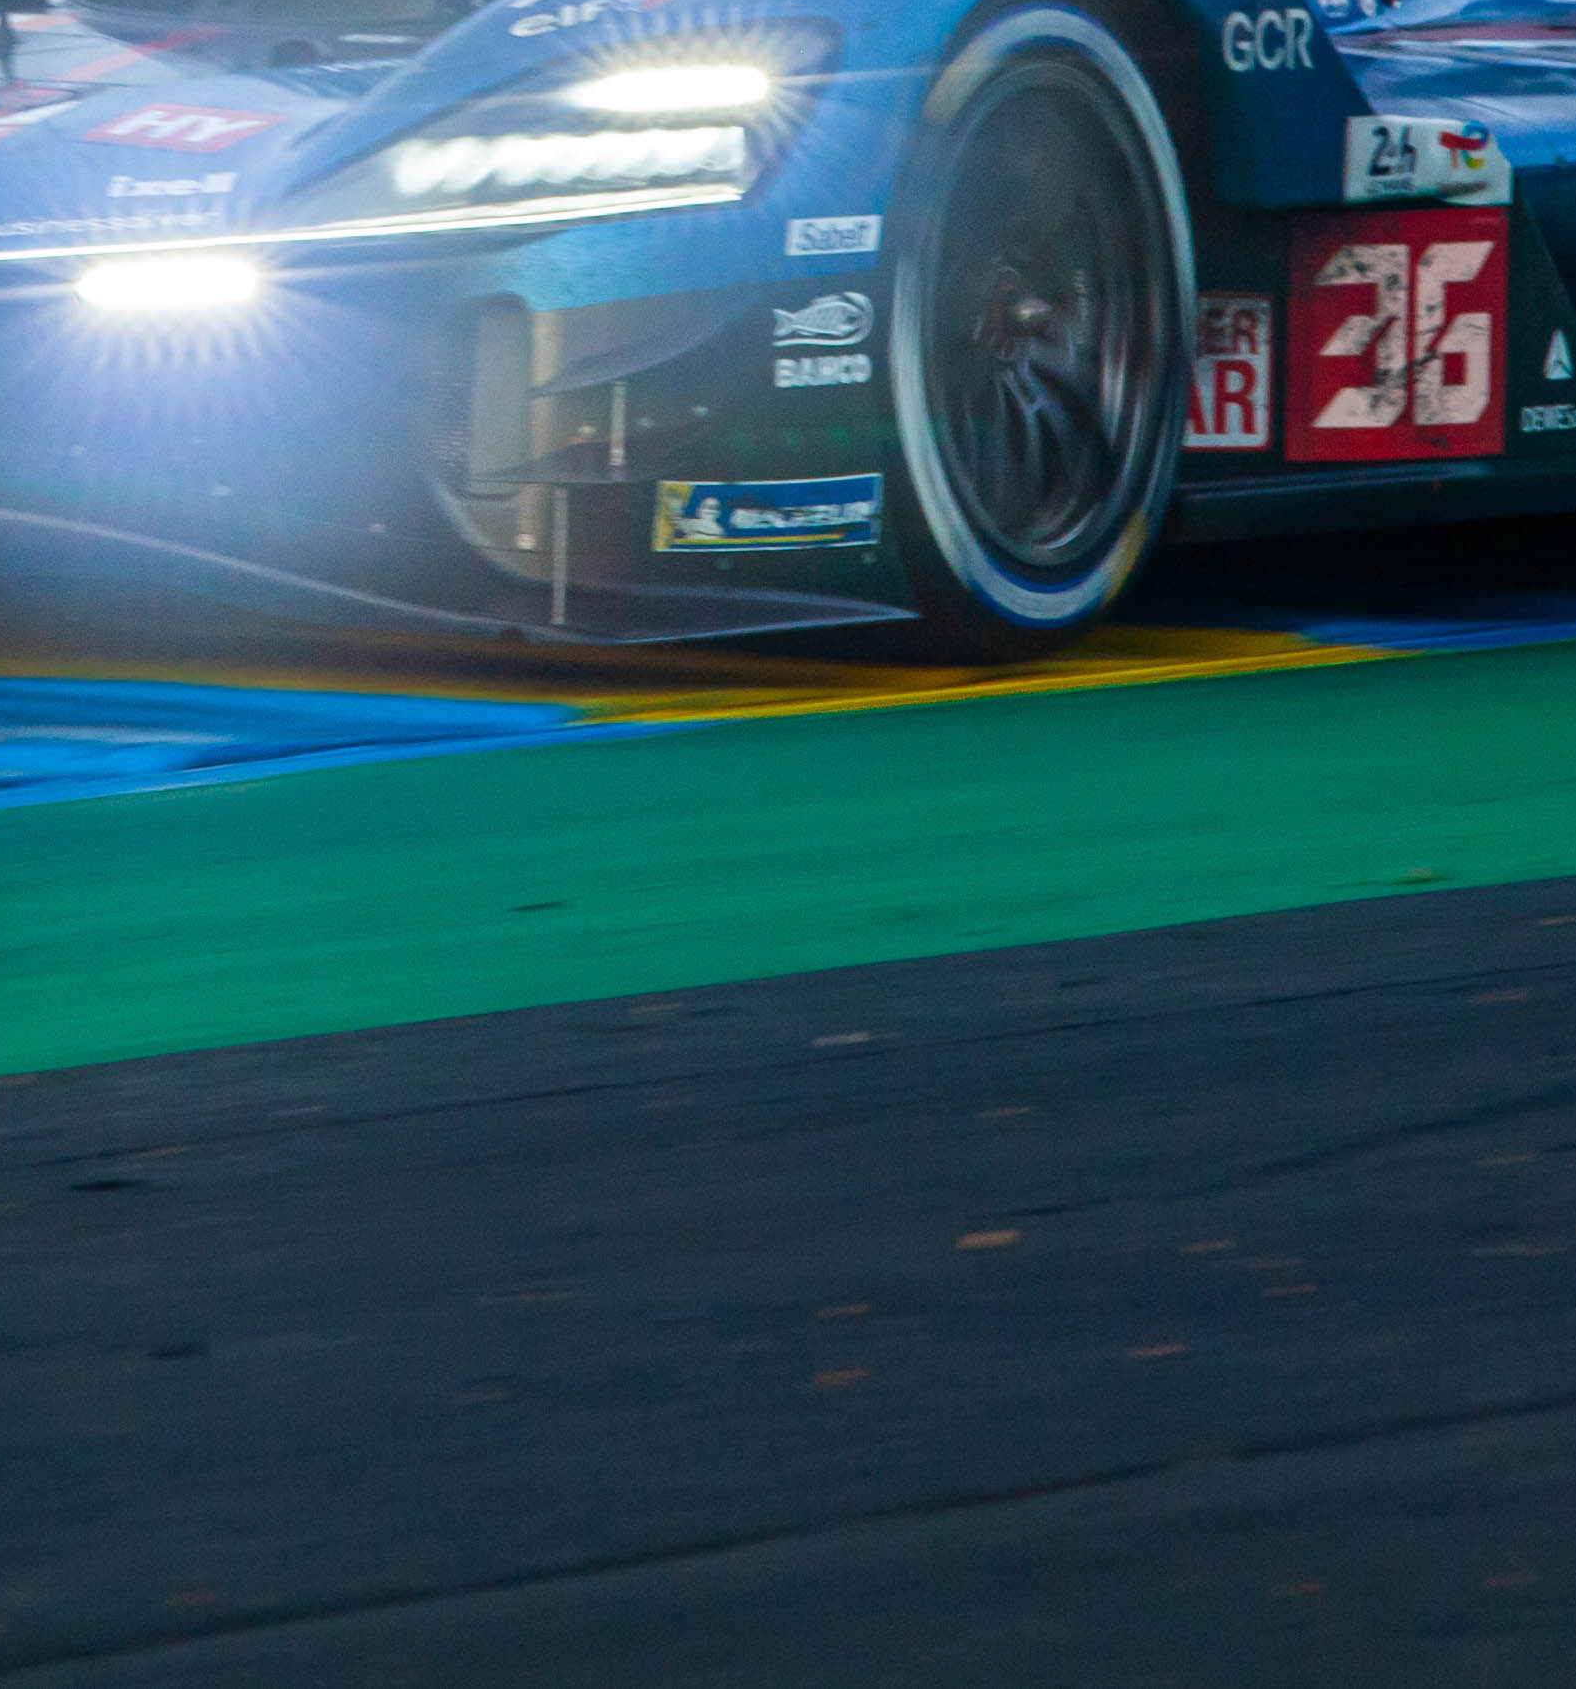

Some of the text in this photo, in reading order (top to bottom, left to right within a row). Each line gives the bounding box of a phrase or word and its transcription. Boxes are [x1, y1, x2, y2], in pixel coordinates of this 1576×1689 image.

[1223, 8, 1315, 73] GCR
[102, 109, 268, 143] HY
[1310, 240, 1496, 429] 36
